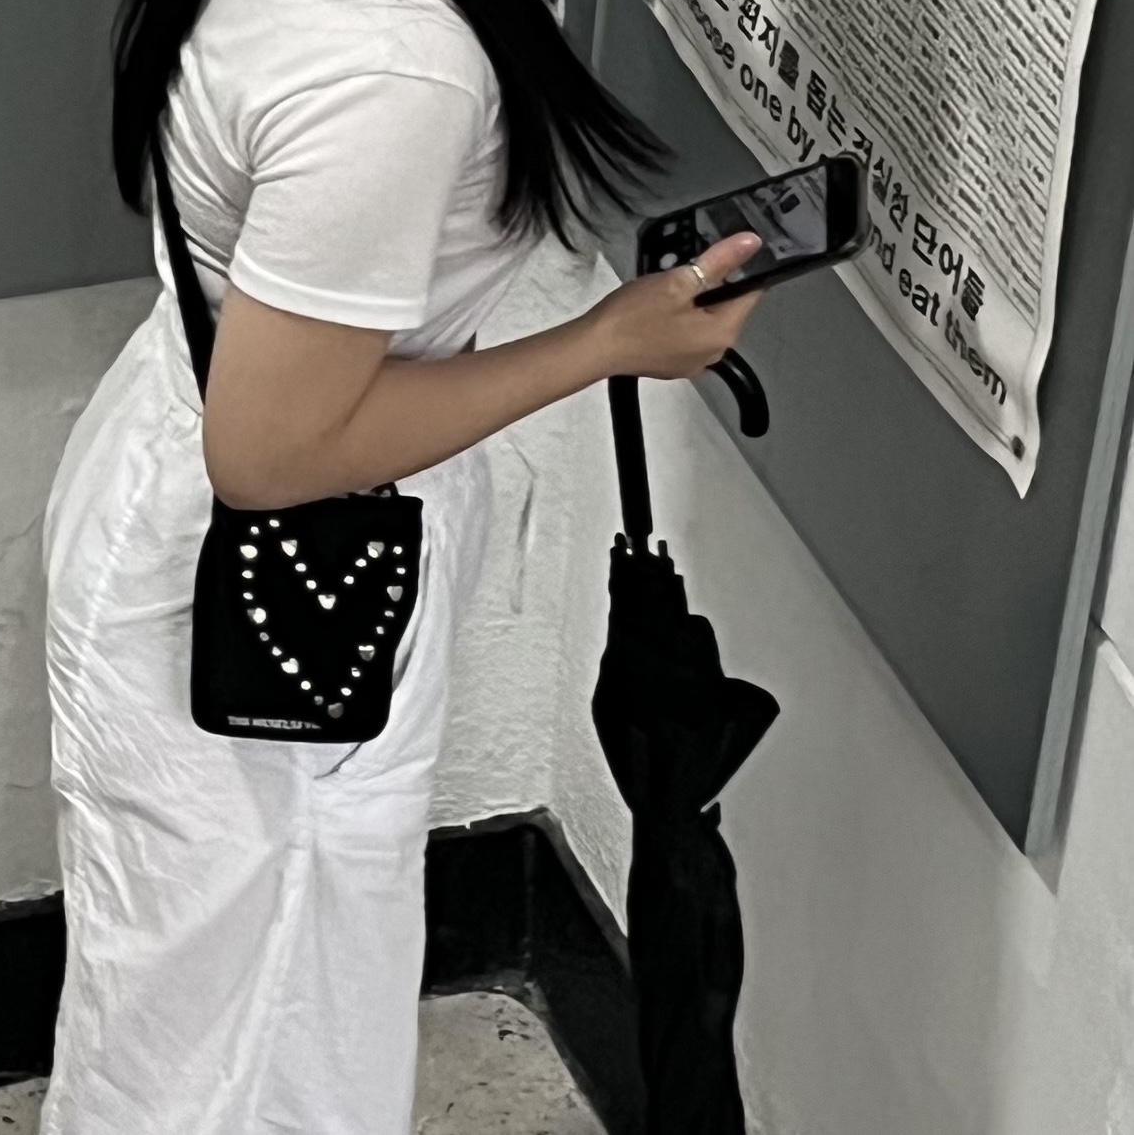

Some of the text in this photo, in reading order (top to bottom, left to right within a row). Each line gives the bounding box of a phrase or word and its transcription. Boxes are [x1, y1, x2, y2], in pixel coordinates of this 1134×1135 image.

[739, 63, 783, 123] one
[787, 105, 815, 163] by
[868, 224, 897, 275] nd
[899, 268, 941, 327] eat
[944, 309, 1007, 406] them
